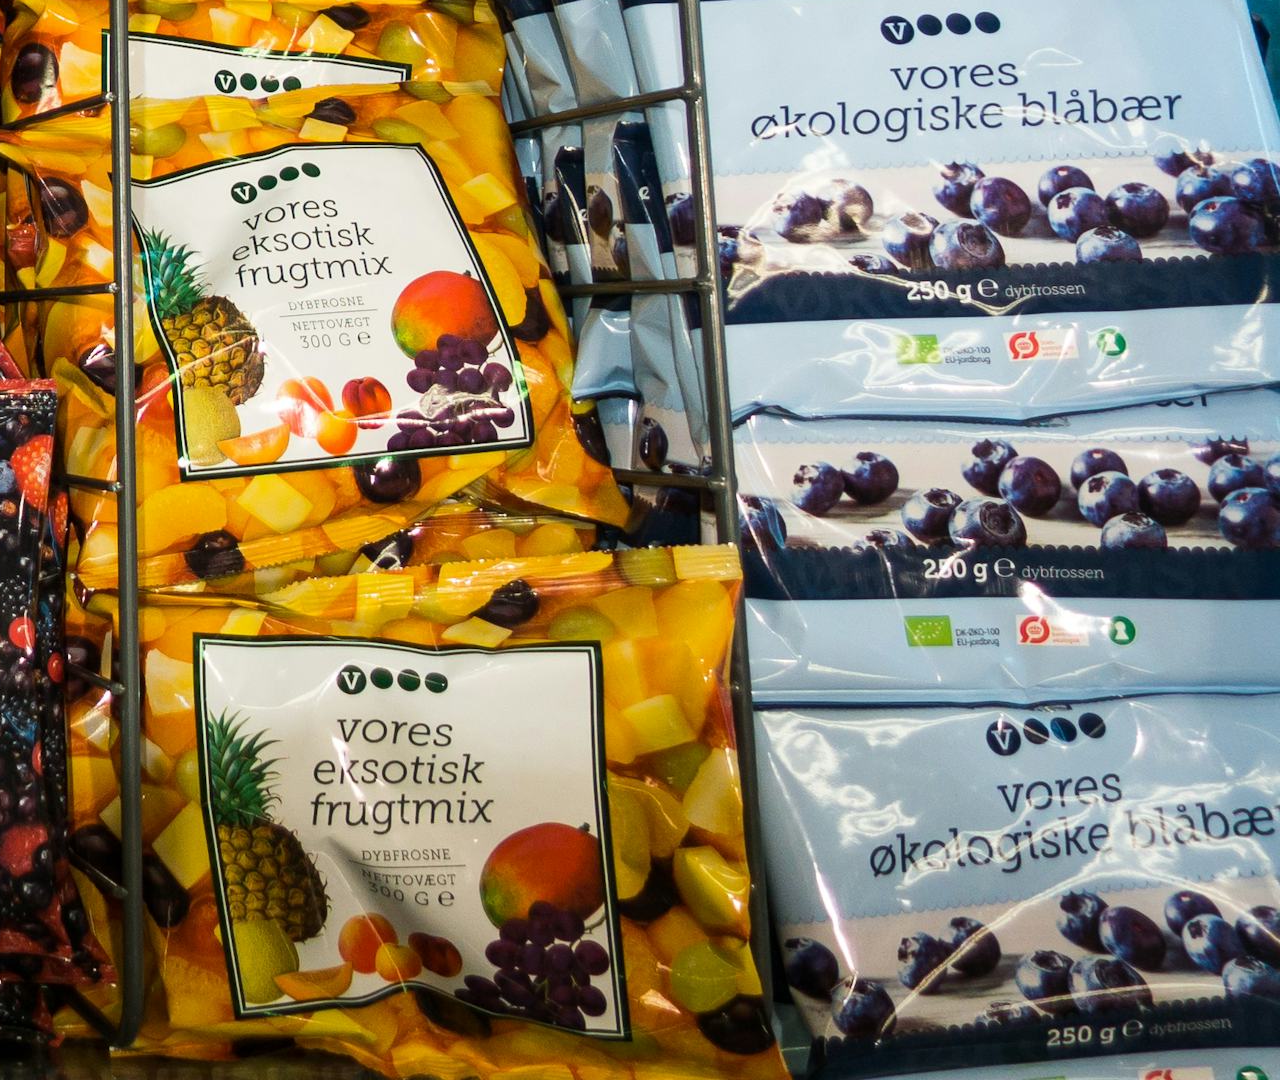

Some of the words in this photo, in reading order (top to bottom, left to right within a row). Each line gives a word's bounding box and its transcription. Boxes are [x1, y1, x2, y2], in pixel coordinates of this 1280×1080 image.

[890, 58, 1019, 92] vores
[750, 98, 1006, 143] økologiske
[1018, 90, 1184, 126] blåbær
[242, 195, 339, 232] vores
[232, 221, 376, 262] eksotisk
[235, 253, 393, 290] frugtmix
[288, 296, 365, 312] DYBFROSNE
[906, 279, 950, 302] 250
[1004, 279, 1086, 299] dybfrossen
[291, 318, 371, 333] NETTOVÆGT
[300, 333, 334, 349] 300
[922, 557, 967, 580] 250
[1021, 564, 1105, 581] dybfrossen
[337, 718, 453, 749] vores
[313, 754, 485, 786] eksotisk
[997, 771, 1123, 813] vores
[310, 792, 495, 835] frugtmix
[361, 848, 452, 863] DYBFROSNE
[869, 818, 1111, 879] økologiske
[361, 868, 457, 888] NETTOVÆGT
[367, 883, 405, 902] 300
[1047, 1026, 1094, 1047] 250
